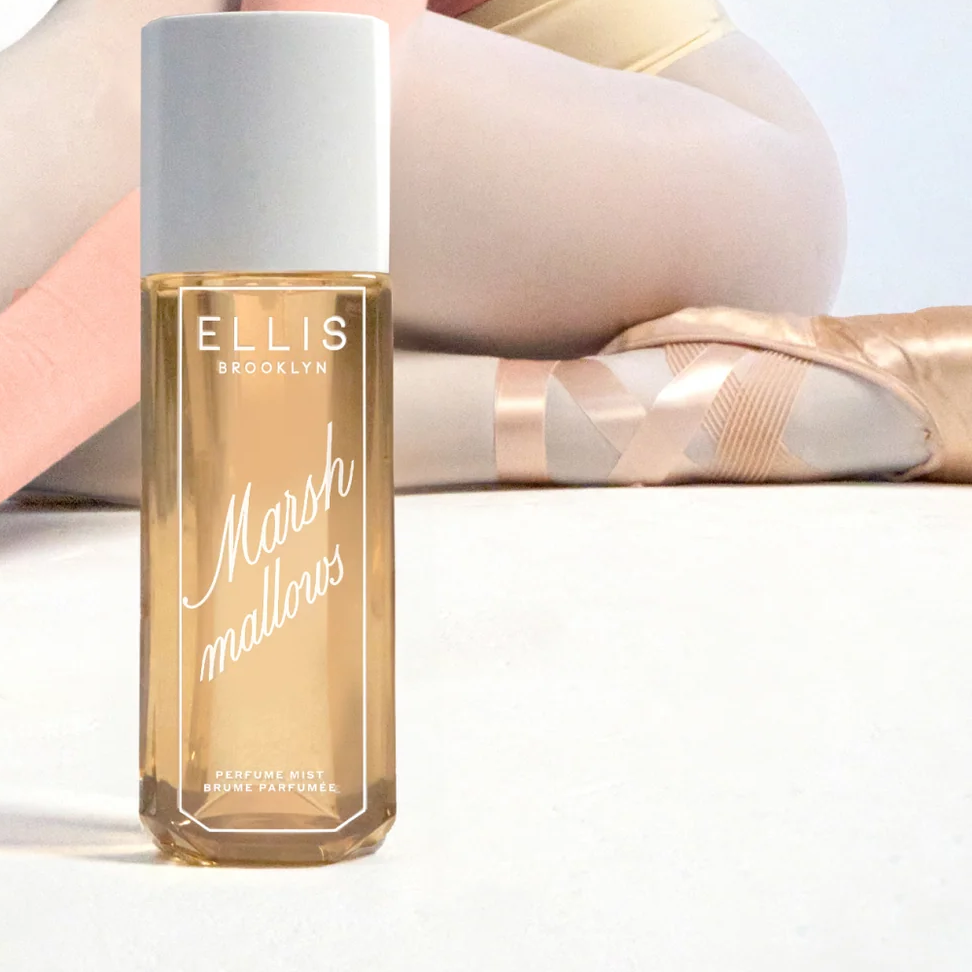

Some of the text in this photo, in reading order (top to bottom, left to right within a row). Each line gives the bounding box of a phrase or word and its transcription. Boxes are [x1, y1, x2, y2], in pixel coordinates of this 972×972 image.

[198, 315, 347, 351] ELLIS
[218, 361, 327, 374] BROOKLYN
[182, 421, 354, 609] Marsh
[200, 544, 344, 682] mallows
[203, 781, 337, 793] BRUME PARFUMÉE
[215, 770, 325, 780] PERFUME MIST
